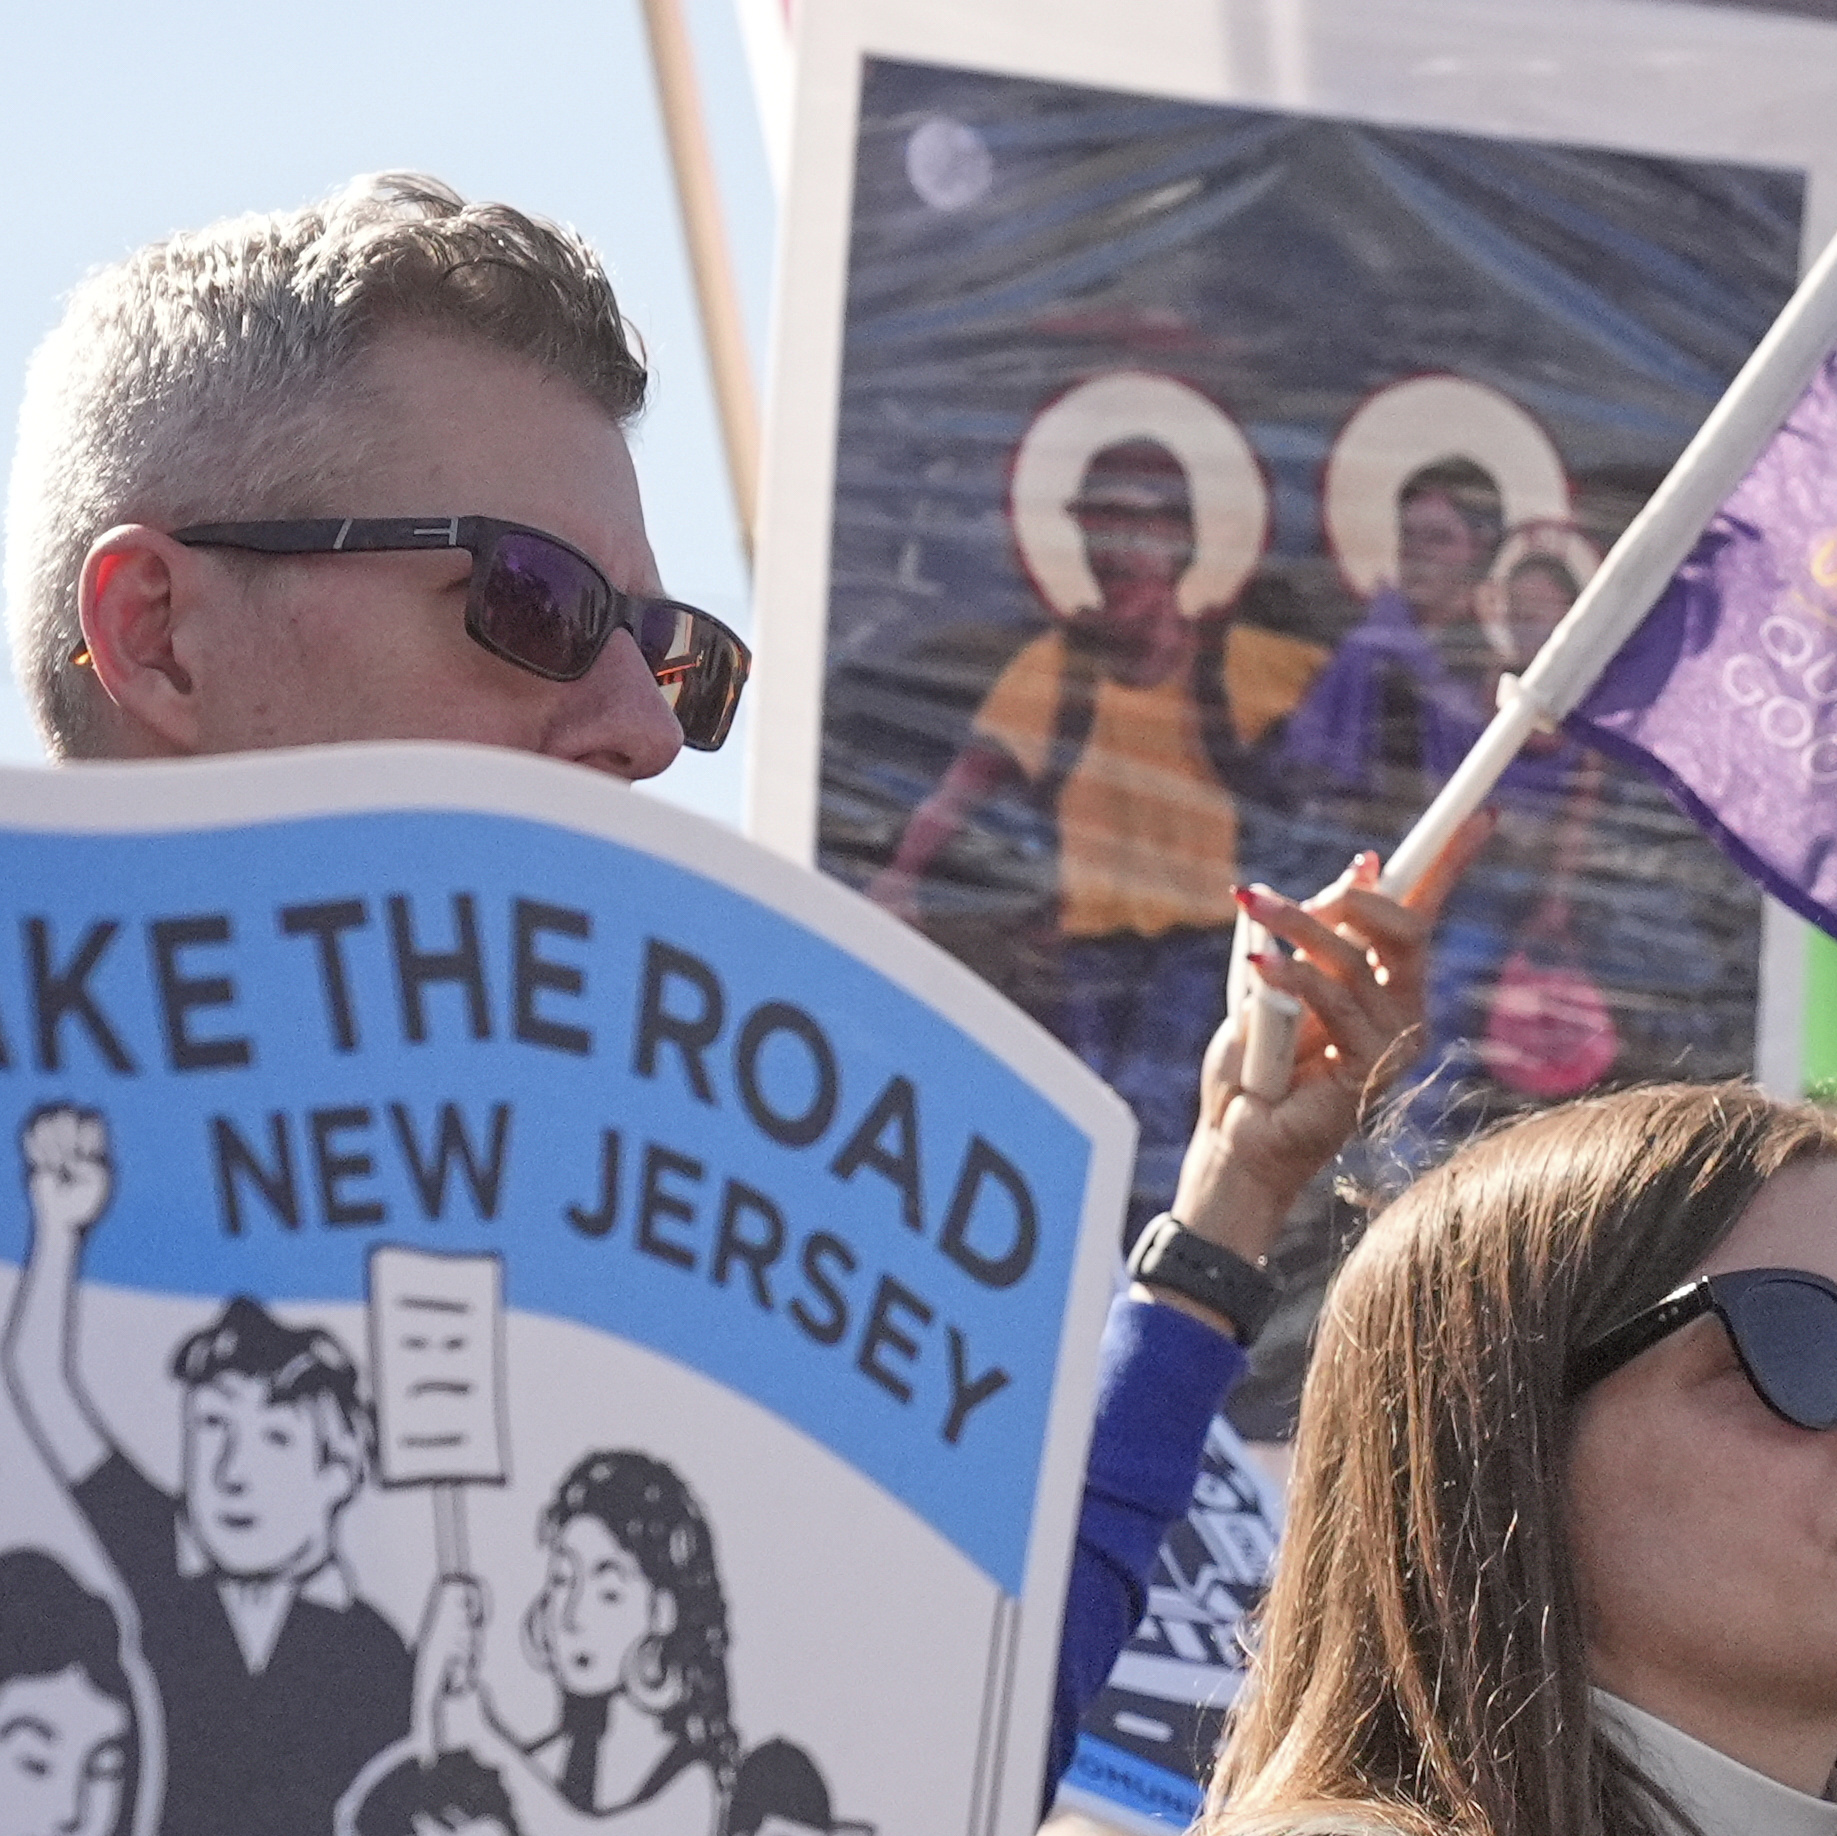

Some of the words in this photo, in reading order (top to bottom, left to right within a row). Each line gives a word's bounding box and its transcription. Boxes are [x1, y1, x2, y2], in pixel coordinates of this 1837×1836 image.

[0, 910, 255, 1078] KE
[279, 890, 596, 1056] THE
[629, 935, 1042, 1292] ROAD
[208, 1099, 515, 1238] NEW
[561, 1127, 1016, 1448] JERSEY
